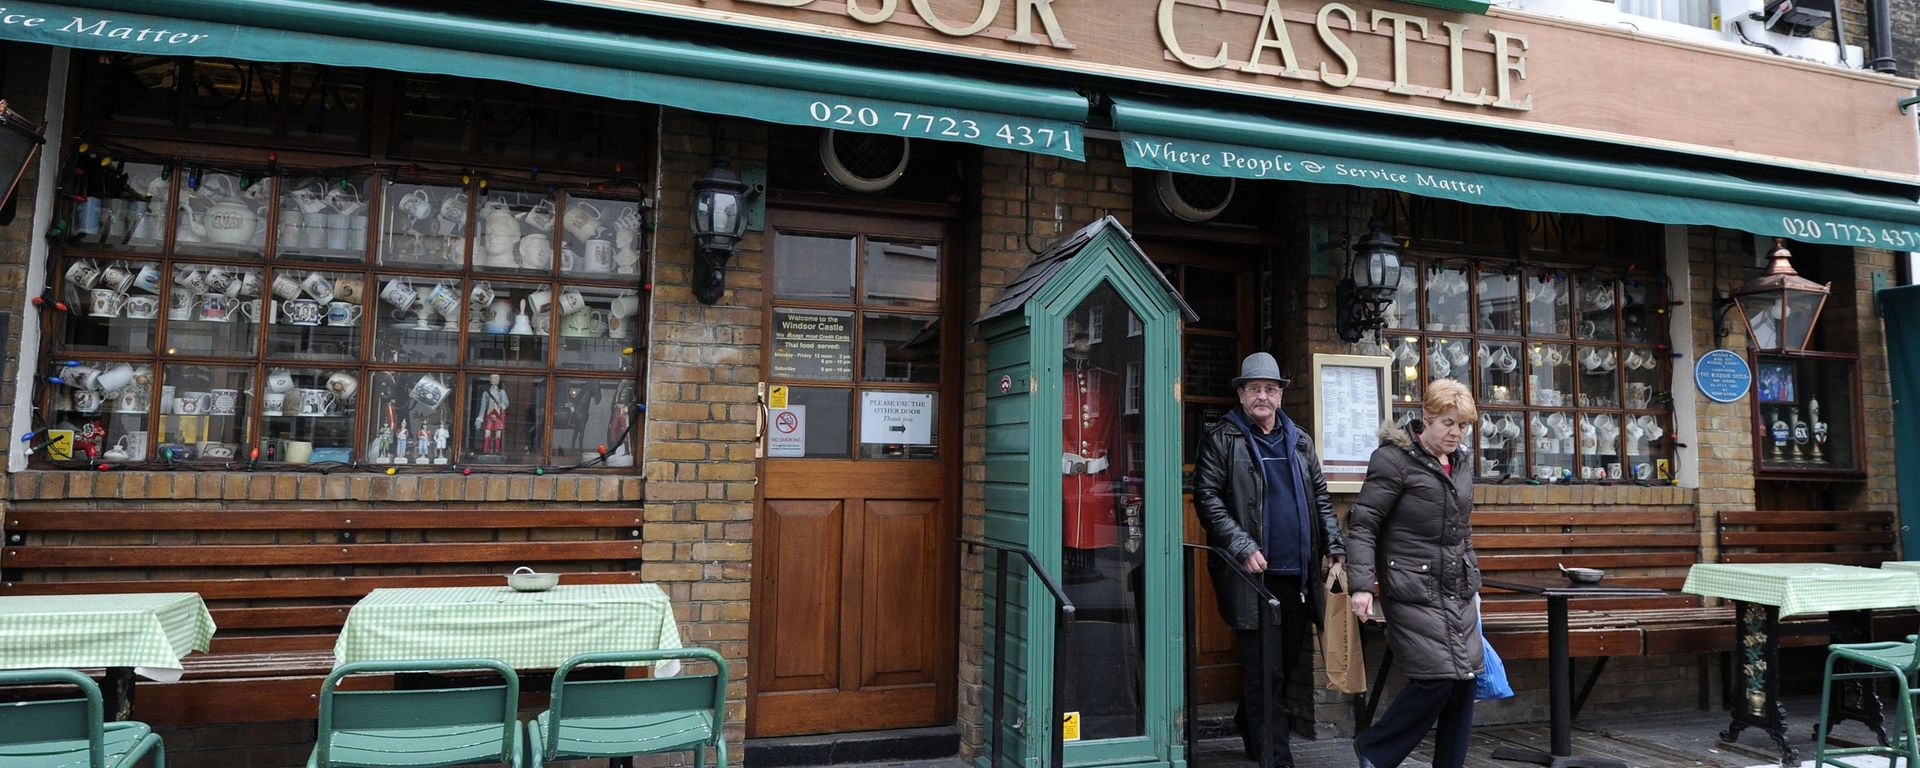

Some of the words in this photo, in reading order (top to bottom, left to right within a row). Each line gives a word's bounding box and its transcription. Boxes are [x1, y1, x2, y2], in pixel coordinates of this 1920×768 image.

[56, 17, 209, 44] Matter
[1157, 0, 1533, 111] CASTLE
[809, 101, 879, 127] 020
[893, 111, 981, 139] 7723
[995, 123, 1074, 152] 4371
[1134, 140, 1211, 166] Where
[1221, 151, 1293, 177] People
[1335, 164, 1408, 184] Service
[1417, 173, 1484, 196] Matter
[1783, 217, 1822, 239] 020
[1825, 223, 1877, 244] 7723
[782, 321, 816, 330] Windsor
[818, 323, 844, 331] Castle
[788, 314, 818, 322] Welcome
[1795, 427, 1808, 438] 6X
